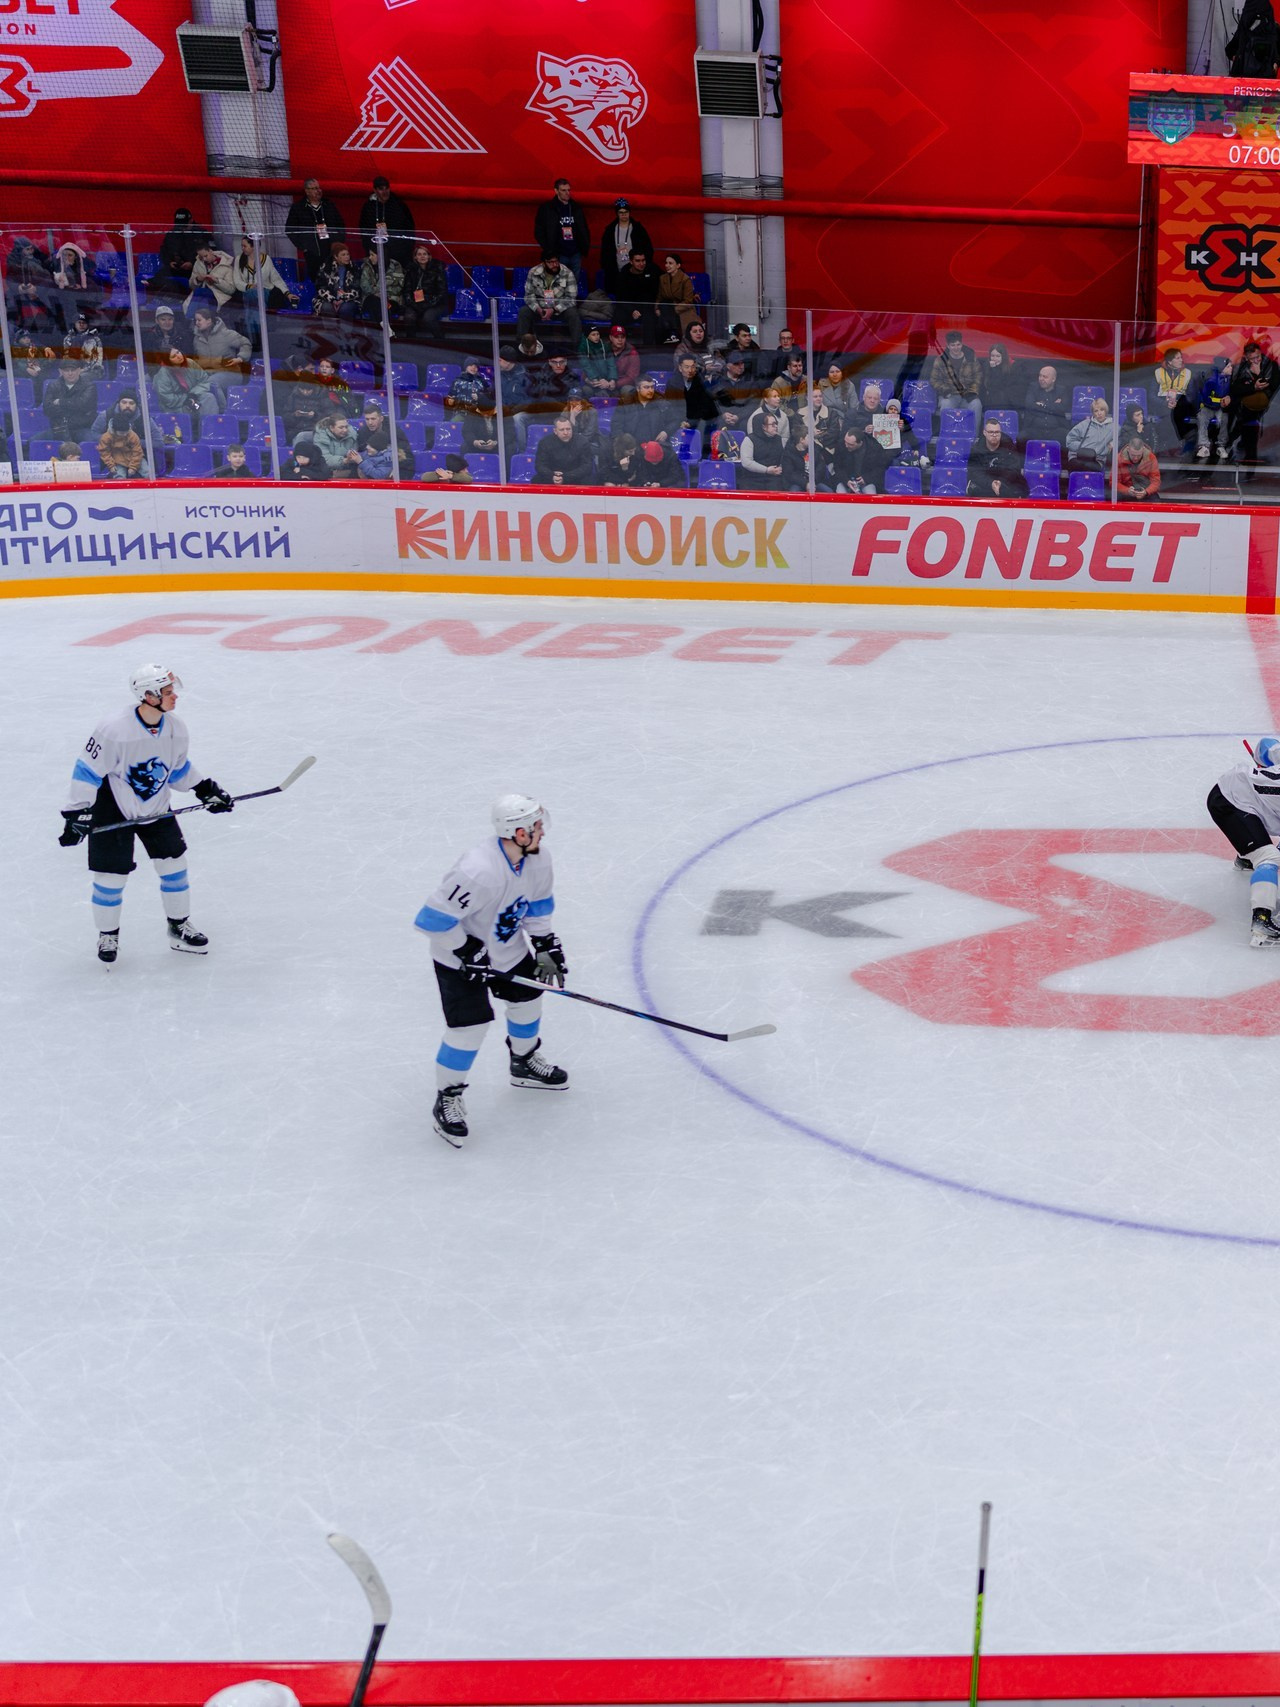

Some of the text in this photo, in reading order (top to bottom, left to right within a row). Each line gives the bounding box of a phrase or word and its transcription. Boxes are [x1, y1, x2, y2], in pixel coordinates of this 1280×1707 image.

[185, 505, 287, 518] ИСТОЧНИК
[395, 507, 790, 569] КИНОПОИСК
[851, 515, 1201, 583] FONBET
[71, 612, 951, 667] FONBET
[86, 736, 102, 760] 86
[447, 884, 471, 909] 14
